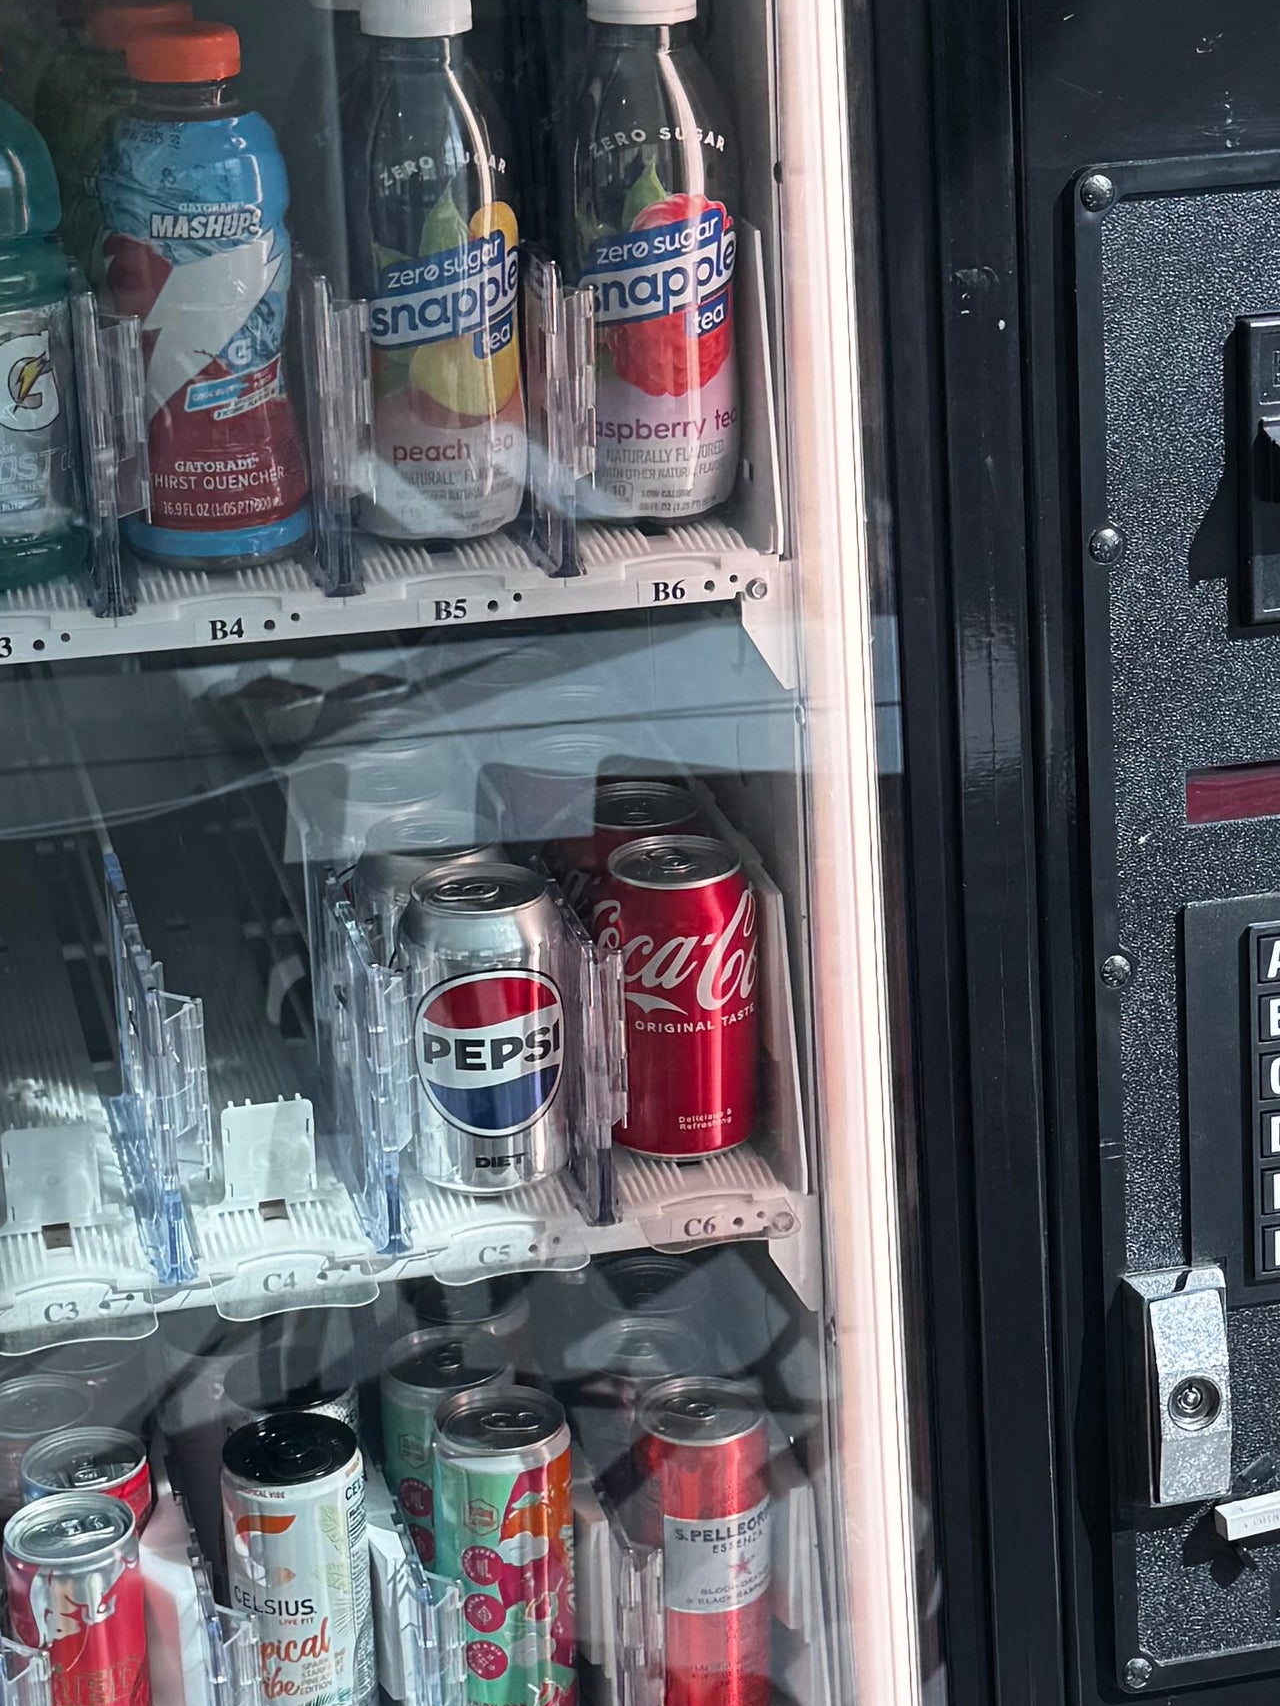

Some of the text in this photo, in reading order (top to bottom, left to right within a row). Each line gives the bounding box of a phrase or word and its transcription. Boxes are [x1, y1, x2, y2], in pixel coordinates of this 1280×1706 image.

[589, 126, 726, 160] ZERO SUGAR
[379, 155, 433, 187] ZERO
[596, 214, 719, 266] zero sugar
[388, 236, 500, 290] zero sugar
[371, 248, 518, 336] snapple
[692, 303, 725, 335] tea
[481, 325, 511, 354] tea
[175, 456, 255, 473] GATORADE
[393, 437, 472, 465] peach
[203, 465, 285, 490] QUENCHER
[651, 579, 686, 603] B6
[433, 598, 468, 622] B5
[209, 618, 245, 642] B4
[635, 1002, 754, 1033] ORIGINAL TASTE
[423, 1018, 560, 1072] PEPSI
[474, 1152, 527, 1169] DIET
[683, 1213, 717, 1238] C6
[478, 1244, 512, 1266] C5
[262, 1272, 297, 1294] C4
[43, 1302, 79, 1325] C3
[234, 1585, 314, 1617] CELSIUS
